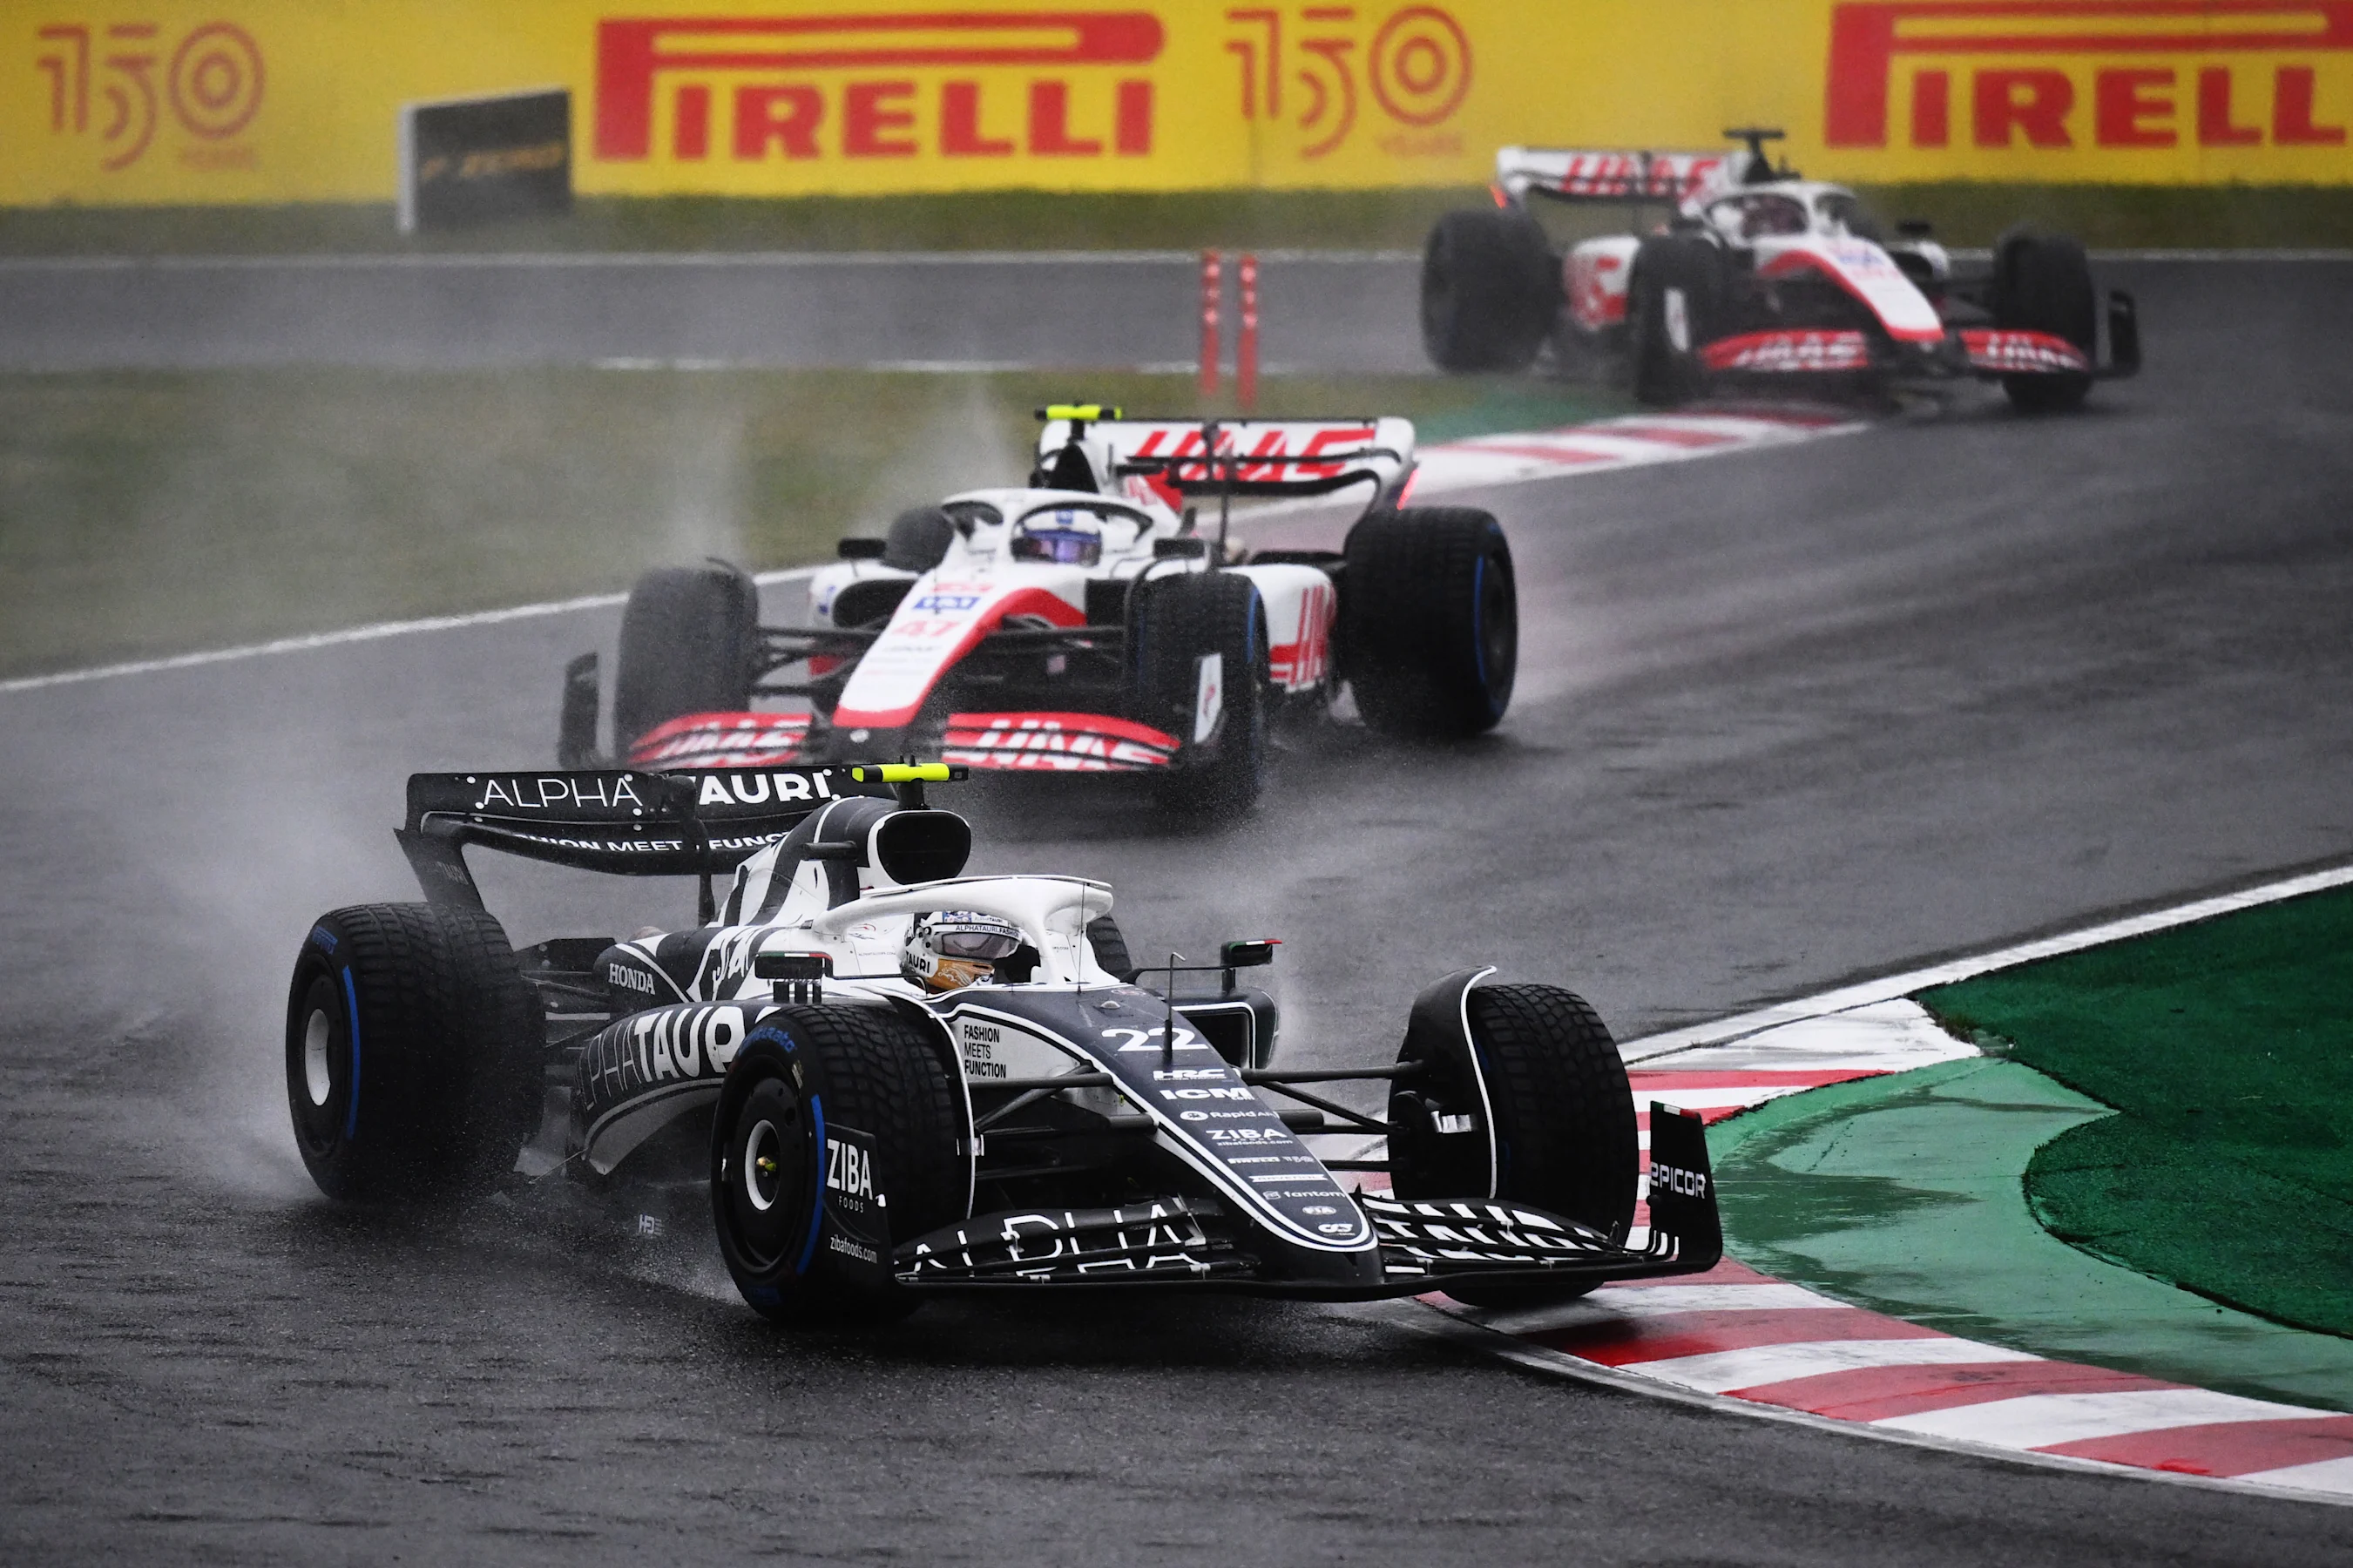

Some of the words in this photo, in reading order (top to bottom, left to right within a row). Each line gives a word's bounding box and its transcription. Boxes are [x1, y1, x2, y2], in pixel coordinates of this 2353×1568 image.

[1823, 0, 2353, 148] PIRELL
[592, 10, 1164, 162] PIRELLI
[608, 840, 700, 852] MEET
[708, 831, 789, 849] FUNC
[608, 963, 656, 995] HONDA
[964, 1024, 999, 1043] FASHION
[1101, 1027, 1209, 1051] 22
[964, 1042, 991, 1059] MEETS
[964, 1059, 1006, 1078] FUNCTION
[1206, 1128, 1288, 1139] ZIBA
[827, 1139, 873, 1200] ZIBA
[839, 1195, 863, 1213] FOODS
[830, 1234, 877, 1263] zibafoods.com
